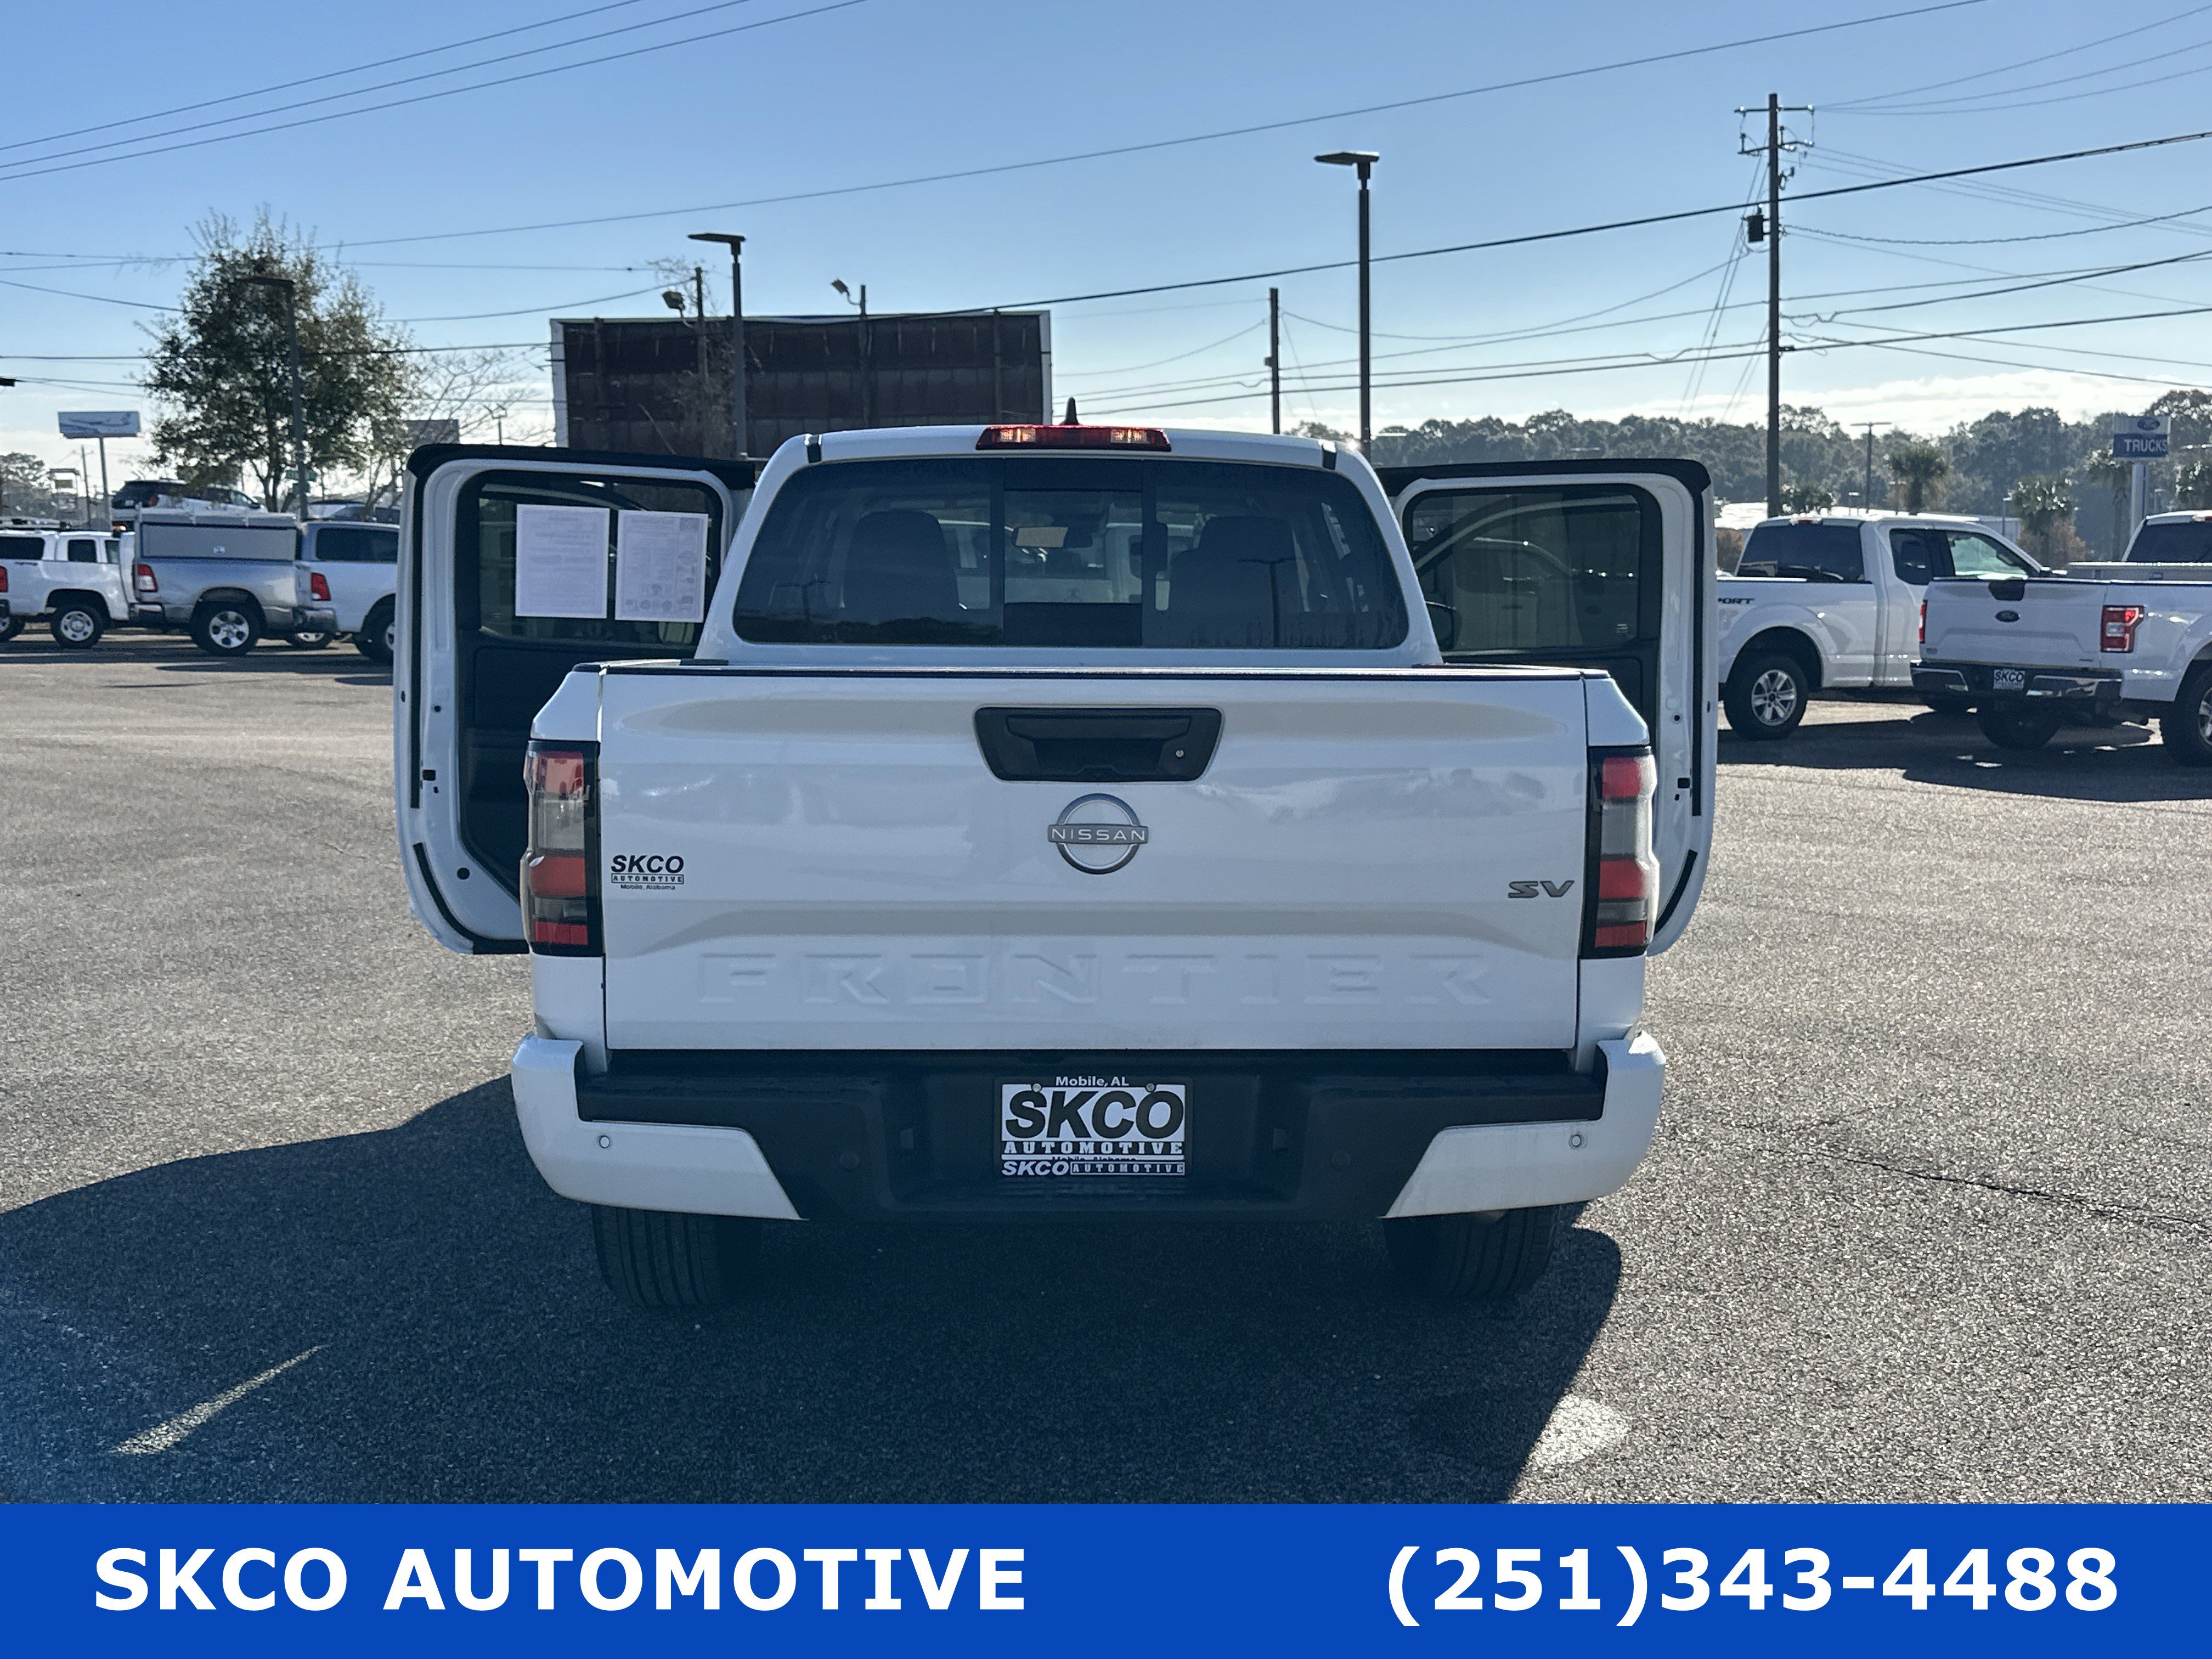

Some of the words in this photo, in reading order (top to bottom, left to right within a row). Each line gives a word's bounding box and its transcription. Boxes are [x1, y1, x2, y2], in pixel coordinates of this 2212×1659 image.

[2124, 438, 2168, 453] TRUCKS
[1994, 670, 2024, 682] SKCO
[1051, 828, 1146, 841] NISSAN
[611, 854, 685, 873] SKCO
[1508, 880, 1575, 899] SV
[699, 952, 1491, 1005] FRONTIER
[1055, 1076, 1108, 1087] Mobile,
[1111, 1077, 1130, 1086] AL
[1005, 1090, 1184, 1138] SKCO
[1003, 1141, 1183, 1154] AUTOMOTIVE
[1002, 1161, 1070, 1176] SKCO
[1072, 1163, 1183, 1173] AUTOMOTIVE
